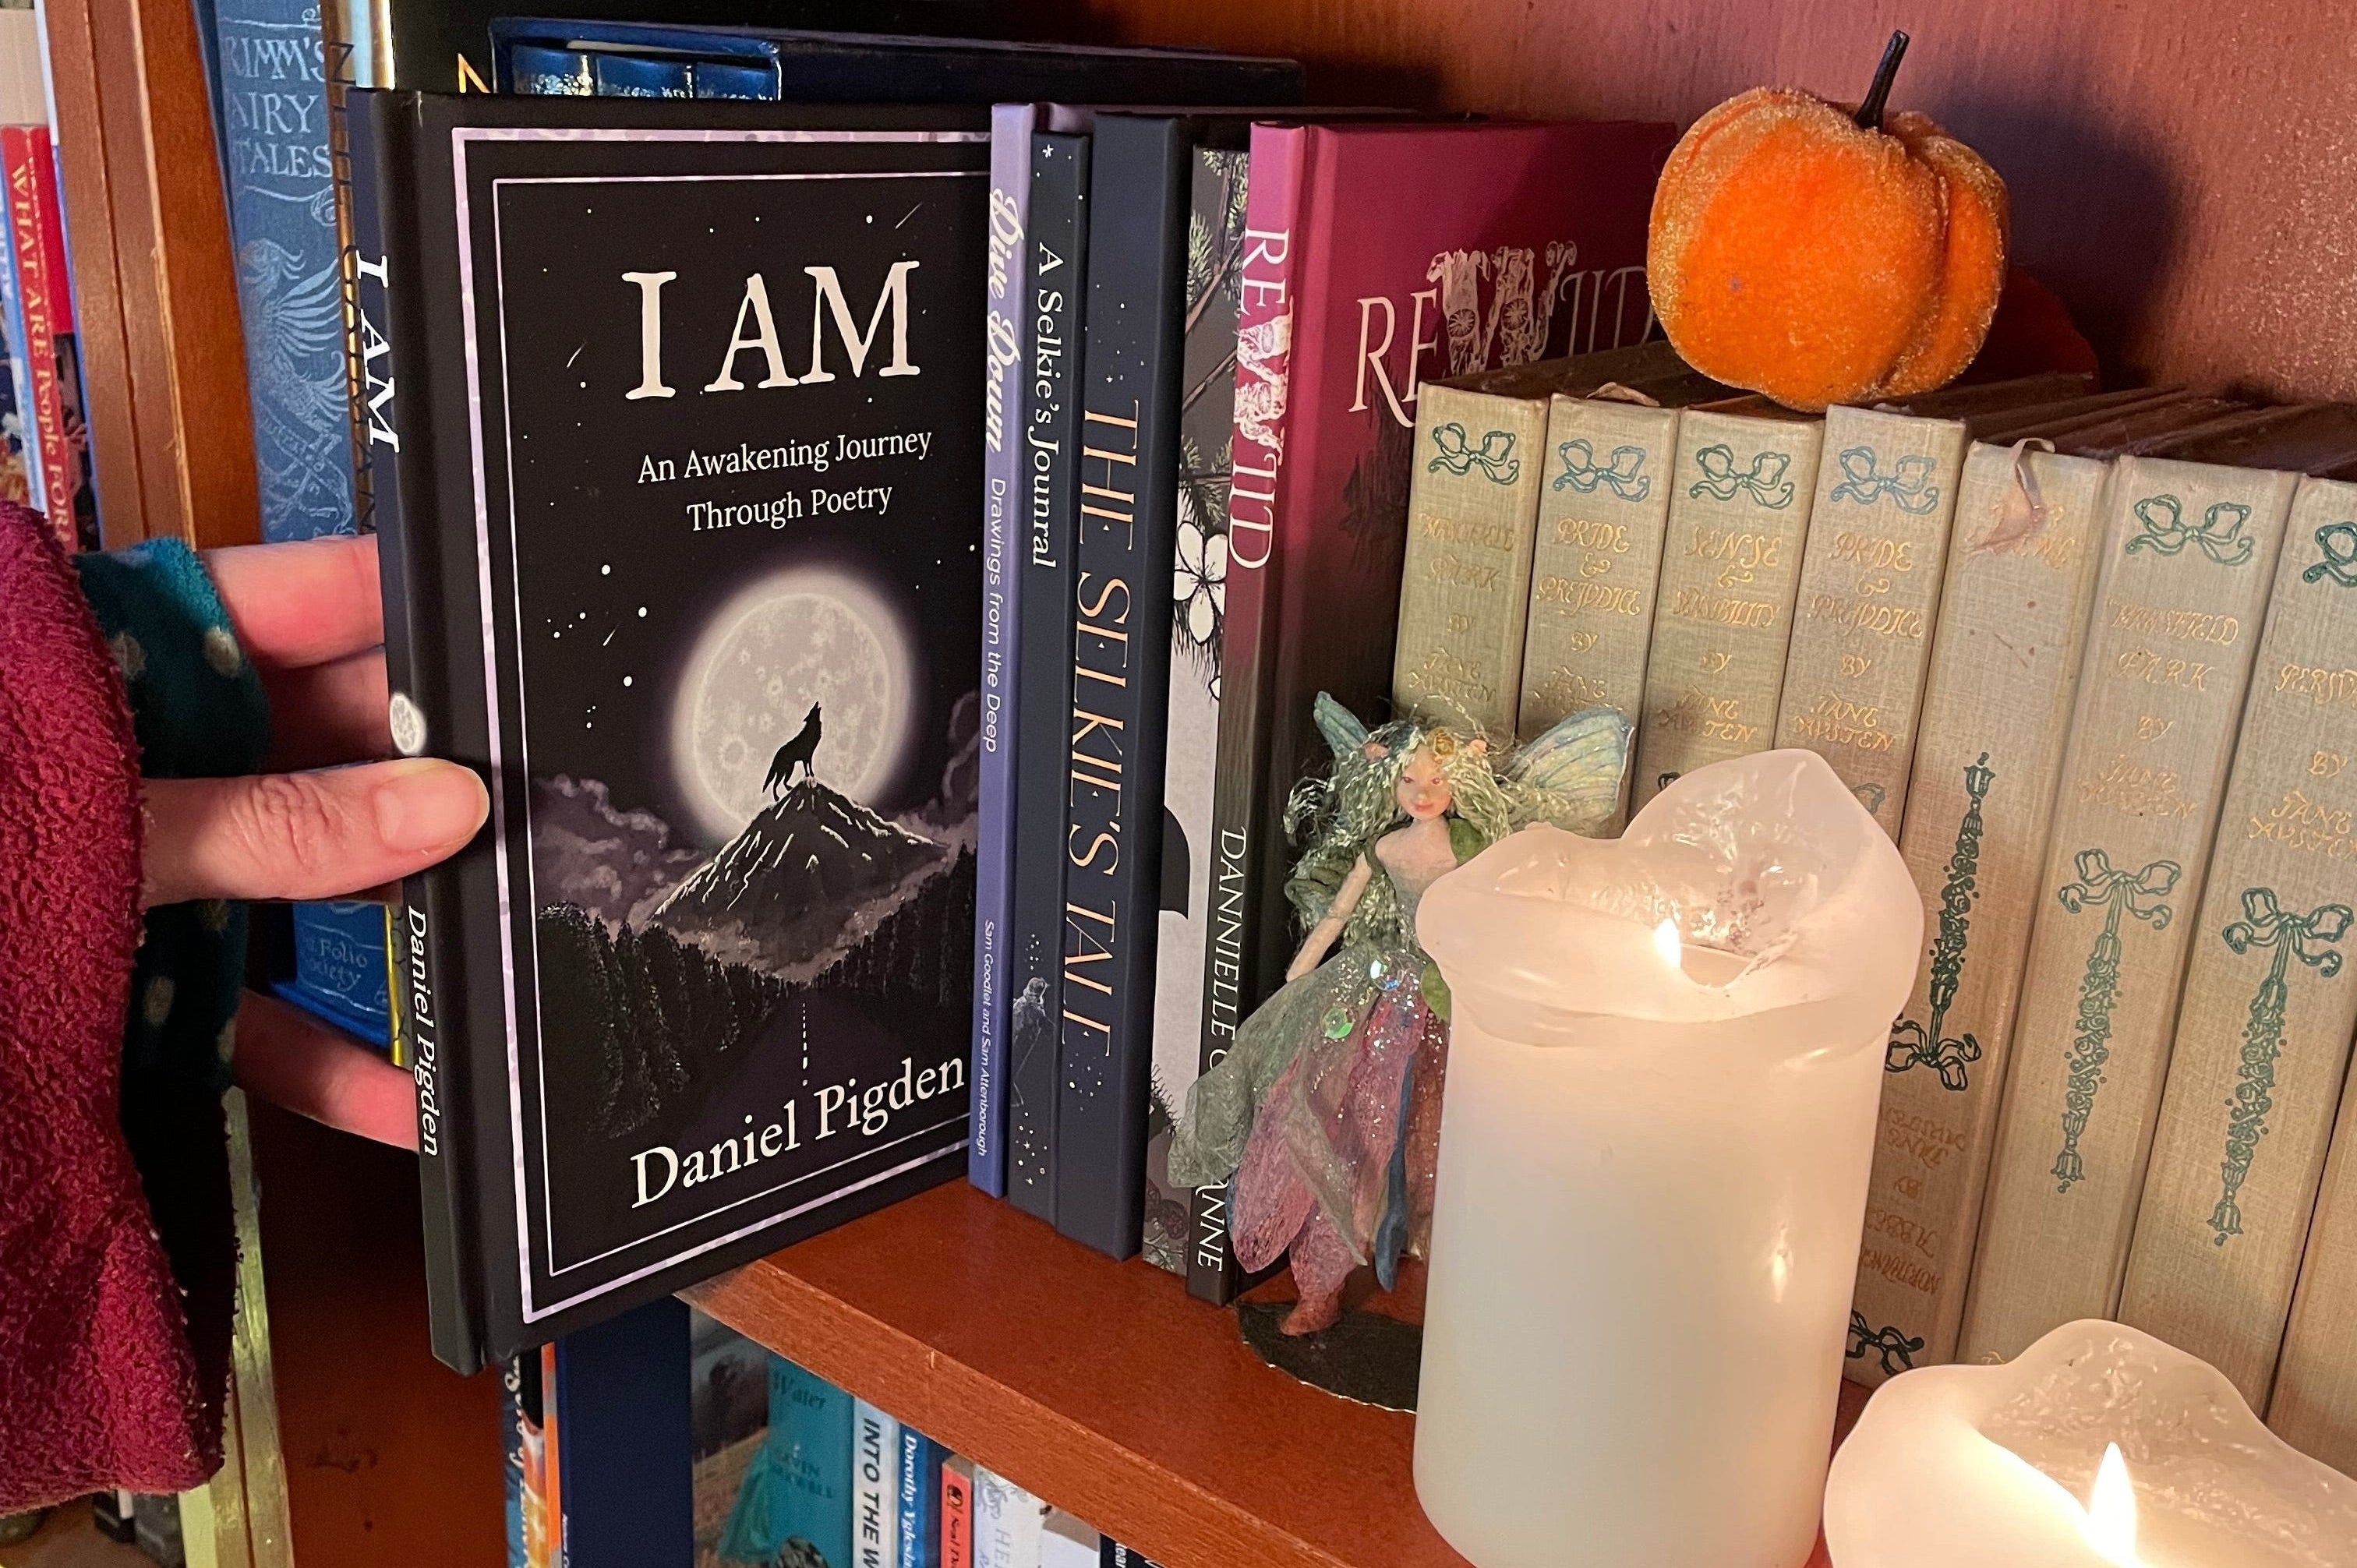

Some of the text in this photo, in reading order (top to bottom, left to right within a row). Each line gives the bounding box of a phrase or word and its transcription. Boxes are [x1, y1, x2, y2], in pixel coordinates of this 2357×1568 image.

[234, 137, 334, 178] TALES
[12, 164, 39, 278] WHAT
[355, 249, 388, 288] I
[27, 287, 49, 357] ARE
[621, 260, 921, 401] I AM
[986, 189, 1024, 453] Dive Down
[360, 309, 400, 454] AM
[37, 369, 60, 455] People
[1027, 242, 1064, 568] A Selkie's Jounral
[638, 430, 932, 484] An Awakening Journey
[686, 485, 893, 532] Through Poetry
[1552, 517, 1631, 553] PRIDE
[1684, 525, 1783, 570] SENSE
[1827, 531, 1914, 572] PRIDE
[1580, 552, 1612, 578] &
[1717, 563, 1754, 588] &
[1855, 568, 1891, 598] &
[982, 478, 1006, 754] Drawings from the Deep
[1839, 654, 1871, 678] BY
[1061, 398, 1140, 1058] THE SELKIE'S TALE
[1810, 690, 1879, 728] JANE
[2136, 715, 2175, 742] BY
[1793, 715, 1896, 752] AUSTEN
[2306, 750, 2348, 779] BY
[2271, 789, 2352, 835] JANE
[320, 938, 367, 969] Folio
[984, 919, 995, 952] Sam
[1210, 825, 1247, 1042] DANNIELLE
[408, 905, 440, 1157] Daniel Pigden
[981, 1010, 994, 1036] and
[980, 1037, 992, 1067] Sam
[630, 1055, 965, 1209] Daniel Pigden
[863, 1418, 881, 1483] INTO
[901, 1434, 917, 1507] Dorothy
[863, 1492, 881, 1545] THE
